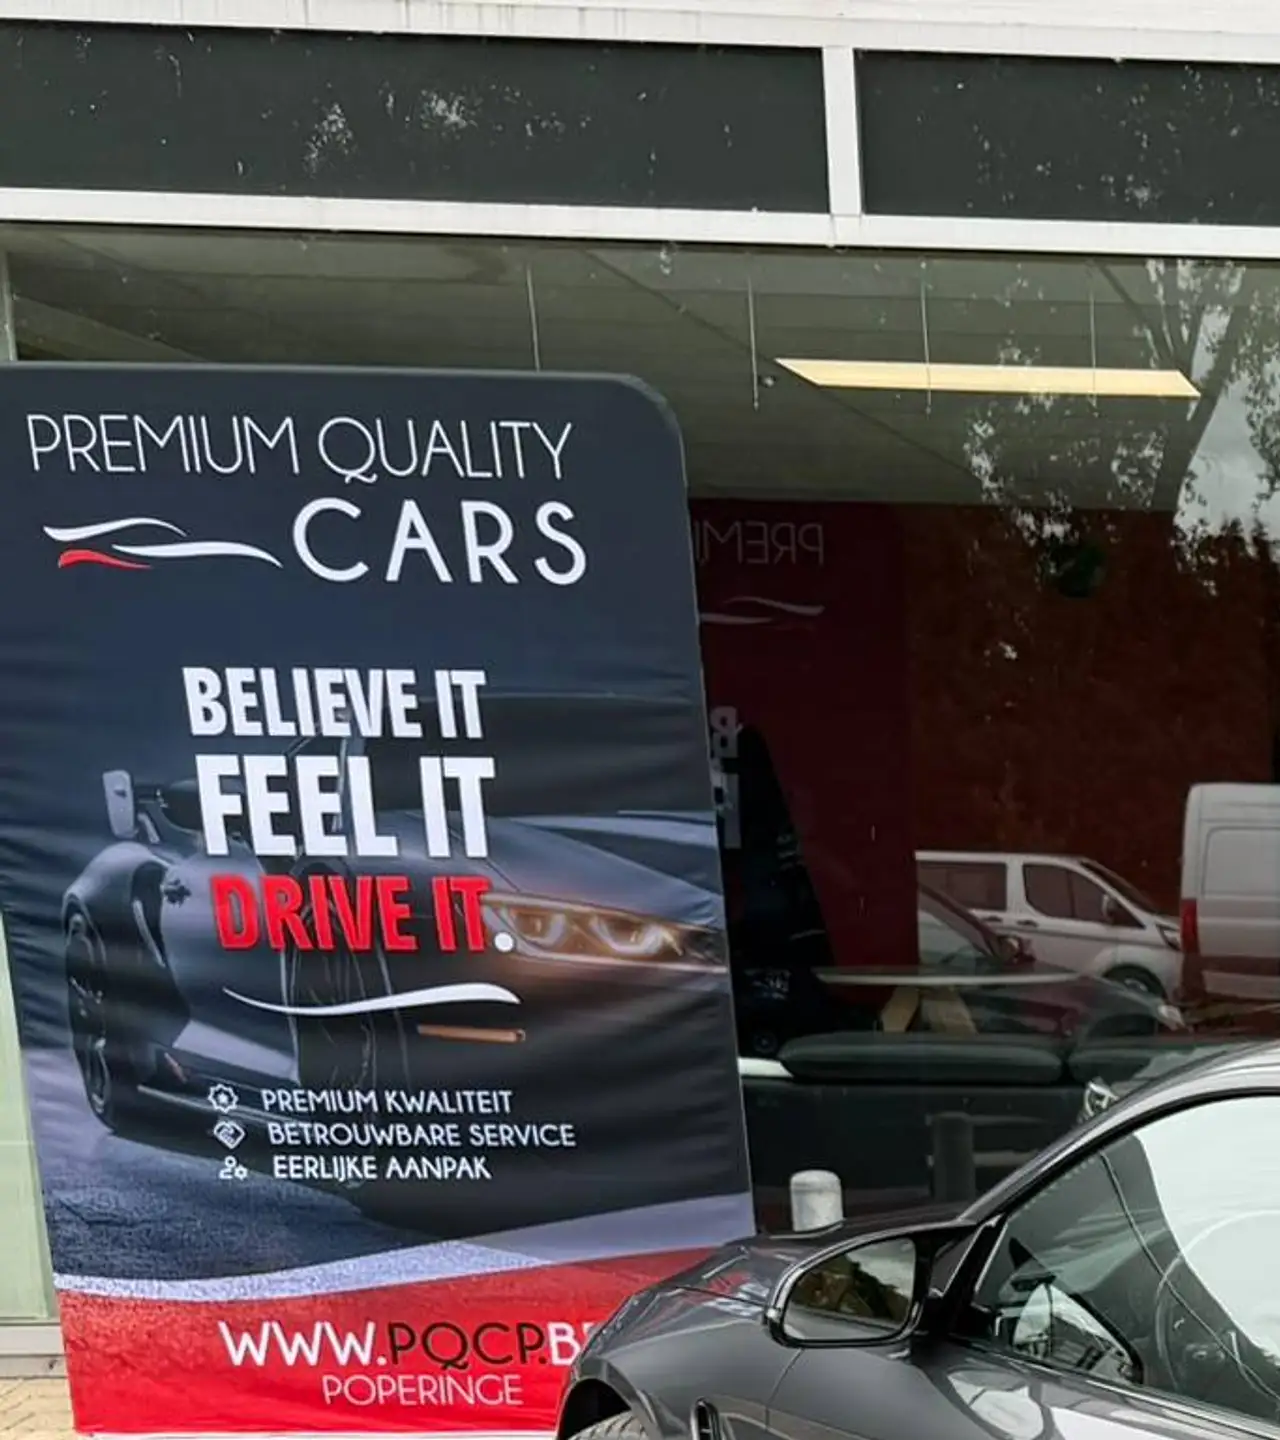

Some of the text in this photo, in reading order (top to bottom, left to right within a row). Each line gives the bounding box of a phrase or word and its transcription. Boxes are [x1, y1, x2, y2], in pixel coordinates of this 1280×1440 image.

[26, 414, 573, 484] PREMIUM QUALITY
[292, 497, 588, 585] CARS
[182, 667, 487, 738] BELIEVE IT
[195, 754, 496, 858] FEEL IT
[210, 873, 516, 953] DRIVE IT.
[262, 1089, 513, 1114] PREMIUM KWALITEIT
[267, 1122, 576, 1147] BETROUWBARE SERVICE
[273, 1155, 492, 1181] EERLIJKE AANPAK
[321, 1374, 524, 1405] POPERINGE
